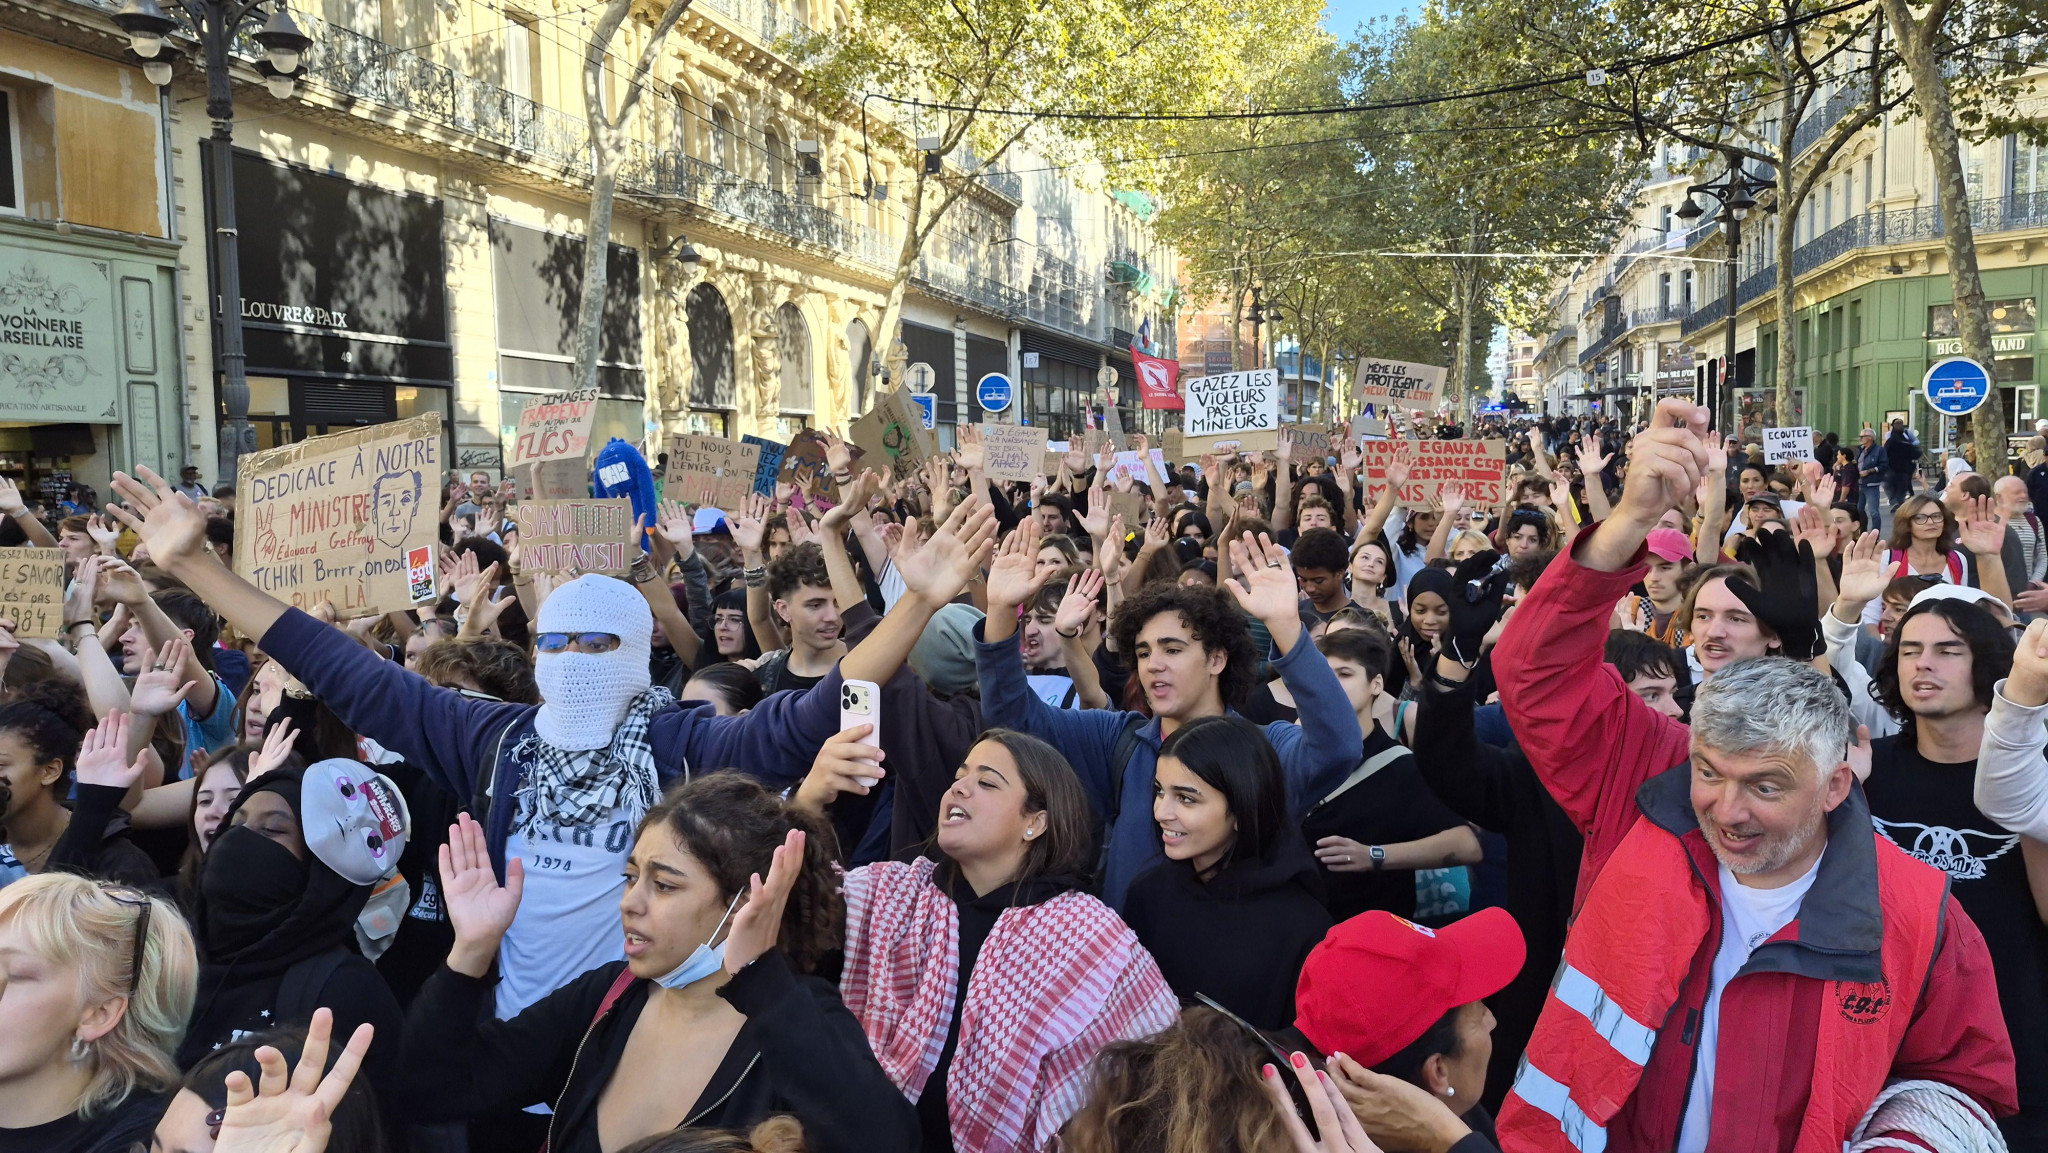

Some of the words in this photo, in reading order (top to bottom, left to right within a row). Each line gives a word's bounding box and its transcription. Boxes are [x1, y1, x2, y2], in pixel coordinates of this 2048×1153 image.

[1591, 73, 1601, 82] 15
[24, 306, 37, 315] LA
[0, 314, 83, 334] VONNERIE
[1936, 342, 1963, 355] BIG
[1992, 338, 2026, 351] NAND
[341, 352, 352, 363] 49
[1367, 362, 1391, 374] MÊME
[1392, 366, 1407, 375] LES
[1657, 370, 1681, 379] L'EMIRE
[1190, 374, 1240, 393] GAZEZ
[1247, 373, 1272, 387] LES
[541, 389, 597, 406] IMAGES
[1363, 386, 1389, 396] MIEUX
[1389, 388, 1406, 398] QUE
[41, 404, 87, 413] ARTISANALE
[521, 402, 593, 426] FRAPPENT
[1207, 406, 1231, 418] PAS
[1234, 403, 1257, 415] LES
[529, 421, 541, 429] PAS
[544, 418, 569, 427] AUTANT
[1768, 429, 1808, 440] ECOUTEZ
[515, 430, 574, 462] FLICS
[674, 436, 692, 448] TU
[701, 440, 732, 455] NOUS
[741, 446, 753, 457] LA
[1365, 441, 1409, 454] TOUS
[1781, 441, 1797, 449] NOS
[351, 445, 364, 479] À
[376, 437, 436, 473] NOTRE
[674, 449, 711, 465] METS
[1007, 452, 1030, 462] MAIS
[1366, 455, 1384, 467] LA
[1390, 456, 1470, 467] ISSANCE
[1770, 449, 1809, 460] ENFANTS
[672, 461, 717, 474] L'ENVERS
[723, 469, 739, 478] ON
[742, 470, 755, 480] TE
[1408, 469, 1430, 480] IEN
[668, 474, 683, 484] LA
[1436, 481, 1500, 503] ARES
[277, 539, 318, 561] Édouard
[329, 530, 375, 554] Geffray
[24, 548, 43, 560] NOUS
[253, 560, 304, 591] TCHIKI
[410, 561, 431, 581] cgt
[344, 578, 367, 609] LÀ
[0, 604, 46, 634] 1984
[534, 855, 572, 872] 1974
[423, 893, 437, 907] cg
